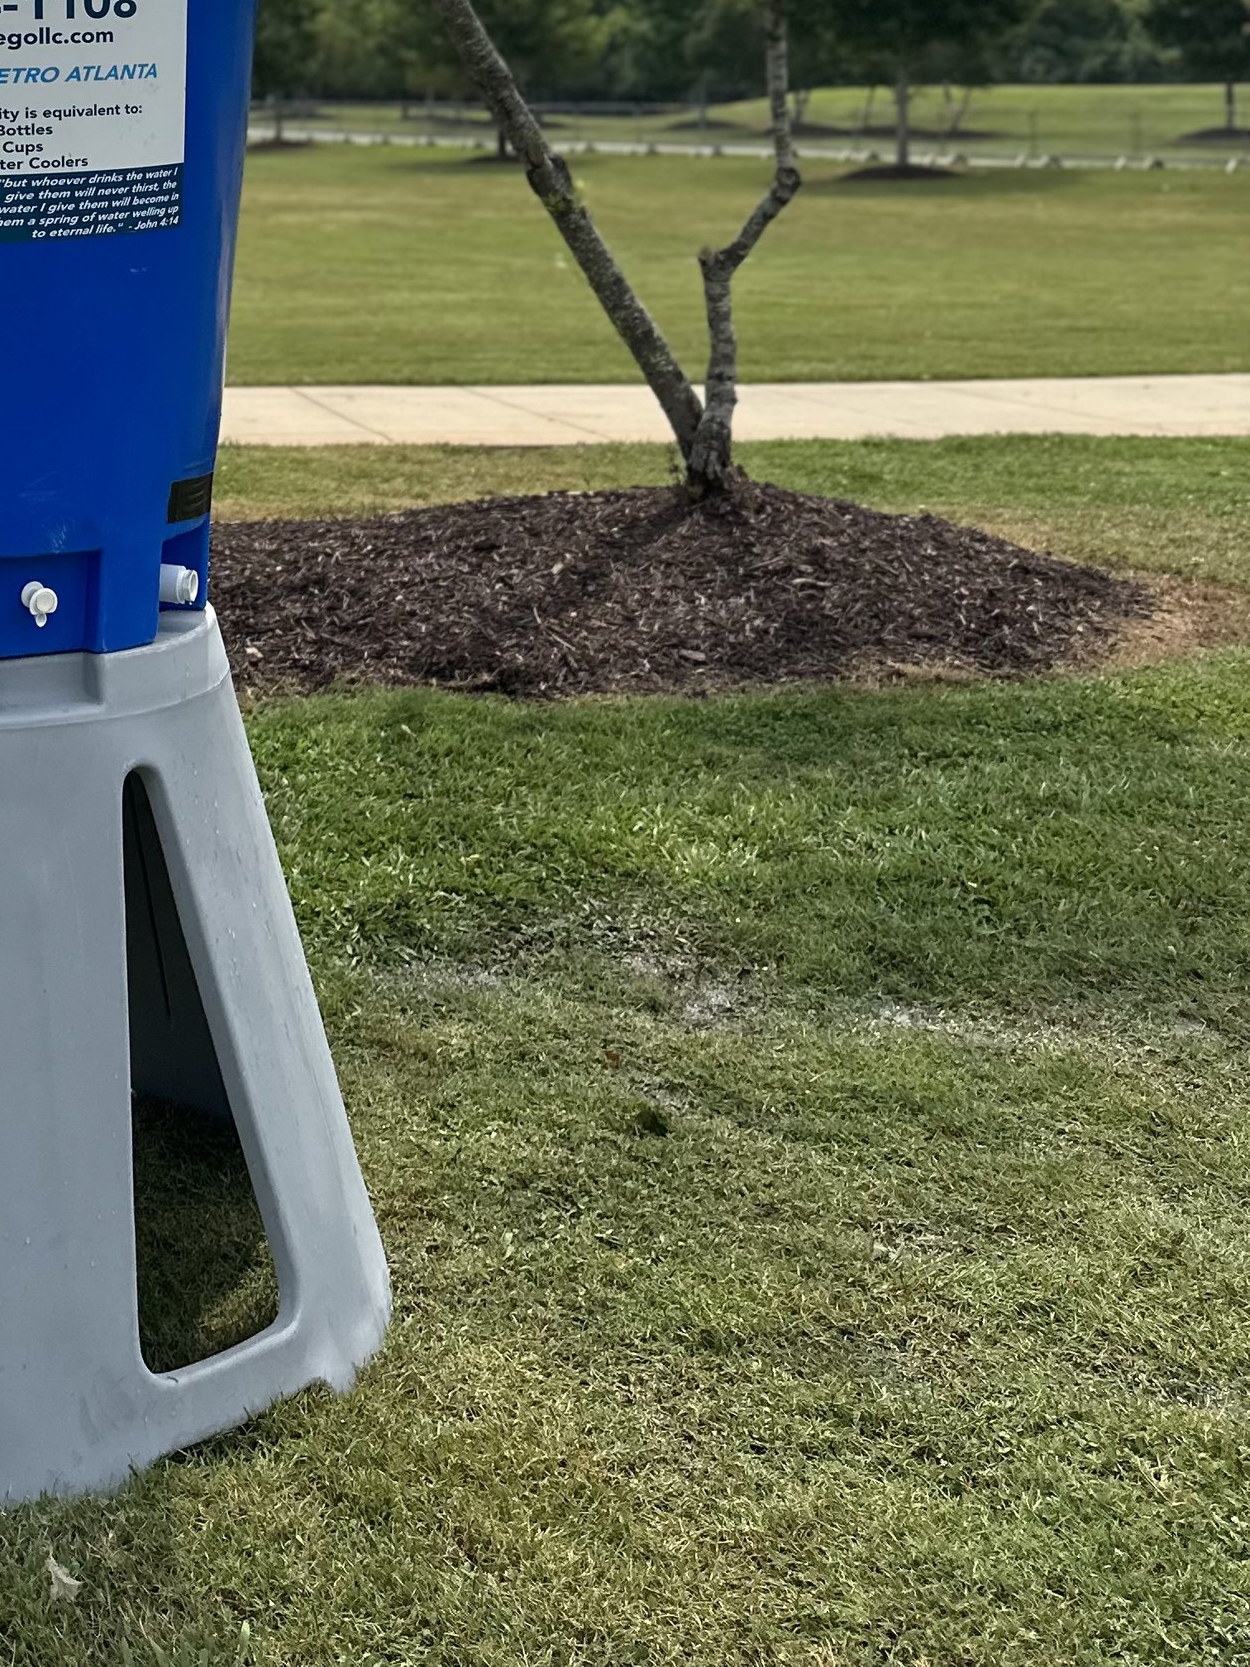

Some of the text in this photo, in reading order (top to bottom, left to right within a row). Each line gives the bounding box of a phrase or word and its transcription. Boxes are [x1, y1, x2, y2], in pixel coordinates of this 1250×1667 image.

[65, 63, 158, 83] ATLANTA
[25, 107, 37, 119] is
[43, 104, 120, 120] equivalent
[125, 104, 143, 115] to:
[2, 141, 44, 156] Cups
[29, 155, 89, 170] Coolers
[31, 176, 87, 187] whoever
[88, 172, 124, 185] drinks
[126, 171, 144, 181] the
[145, 169, 173, 180] water
[4, 179, 178, 204] give them will never thirst, the
[47, 202, 76, 215] give
[78, 200, 109, 211] them
[111, 196, 132, 208] will
[132, 195, 170, 206] become
[170, 191, 180, 202] in
[27, 218, 37, 226] a
[38, 214, 80, 228] spring
[81, 211, 97, 224] of
[97, 210, 131, 222] water
[132, 205, 167, 218] welling
[167, 205, 180, 216] up
[31, 230, 47, 239] to
[49, 224, 94, 238] eternal
[133, 218, 158, 231] John
[159, 214, 180, 228] 4:14
